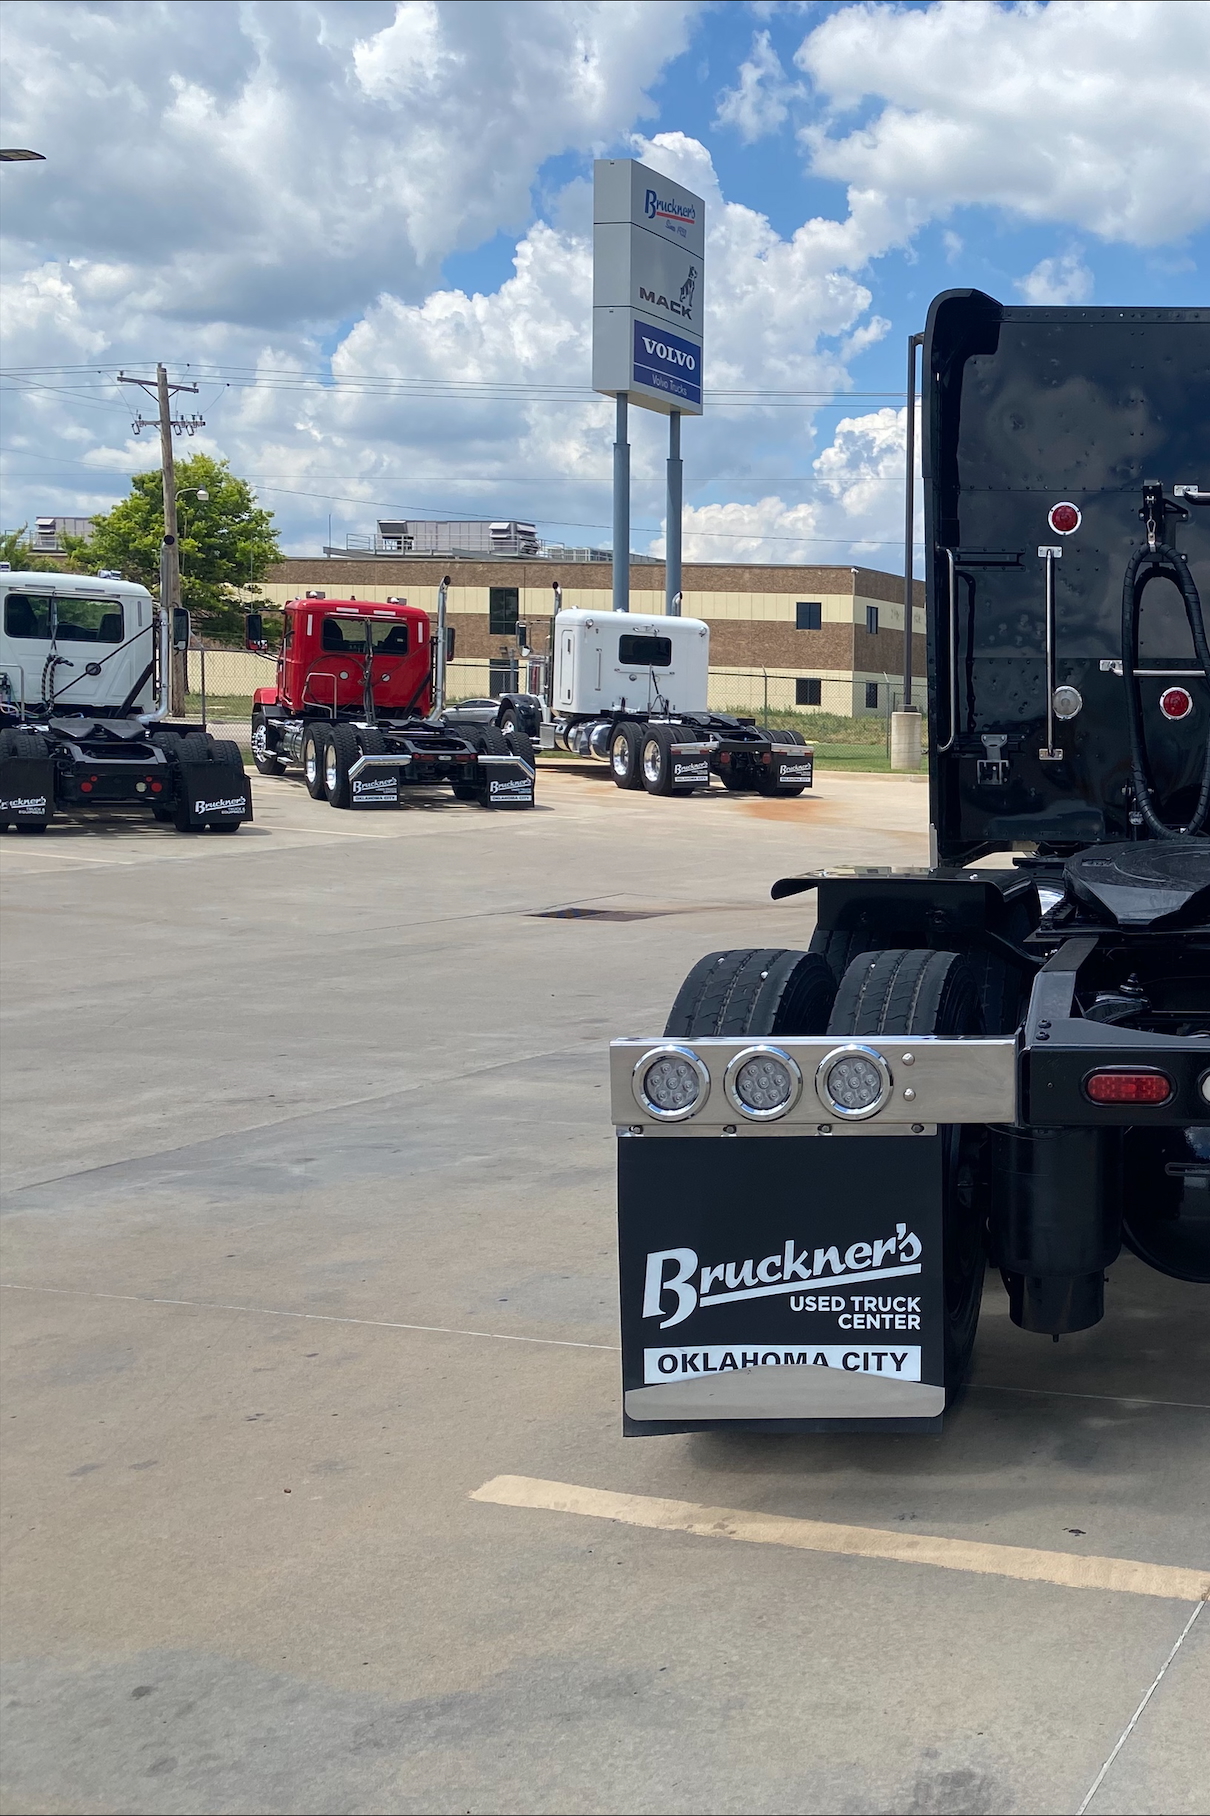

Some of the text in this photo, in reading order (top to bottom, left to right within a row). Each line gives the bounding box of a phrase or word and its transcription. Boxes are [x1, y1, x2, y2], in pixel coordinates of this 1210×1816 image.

[645, 189, 696, 219] Bruckner's
[639, 286, 692, 321] MACK
[641, 336, 696, 371] VOLVO
[652, 374, 688, 396] Volvo Trucks
[352, 776, 398, 794] Bruckner's
[490, 777, 532, 794] Bruckner's
[0, 796, 47, 809] rckner's
[195, 795, 247, 815] Bruckner's
[642, 1222, 922, 1329] Bruckner's
[790, 1296, 921, 1313] USED TRUCK
[838, 1313, 921, 1330] CENTER
[657, 1351, 909, 1374] OKLAHOMA CITY
